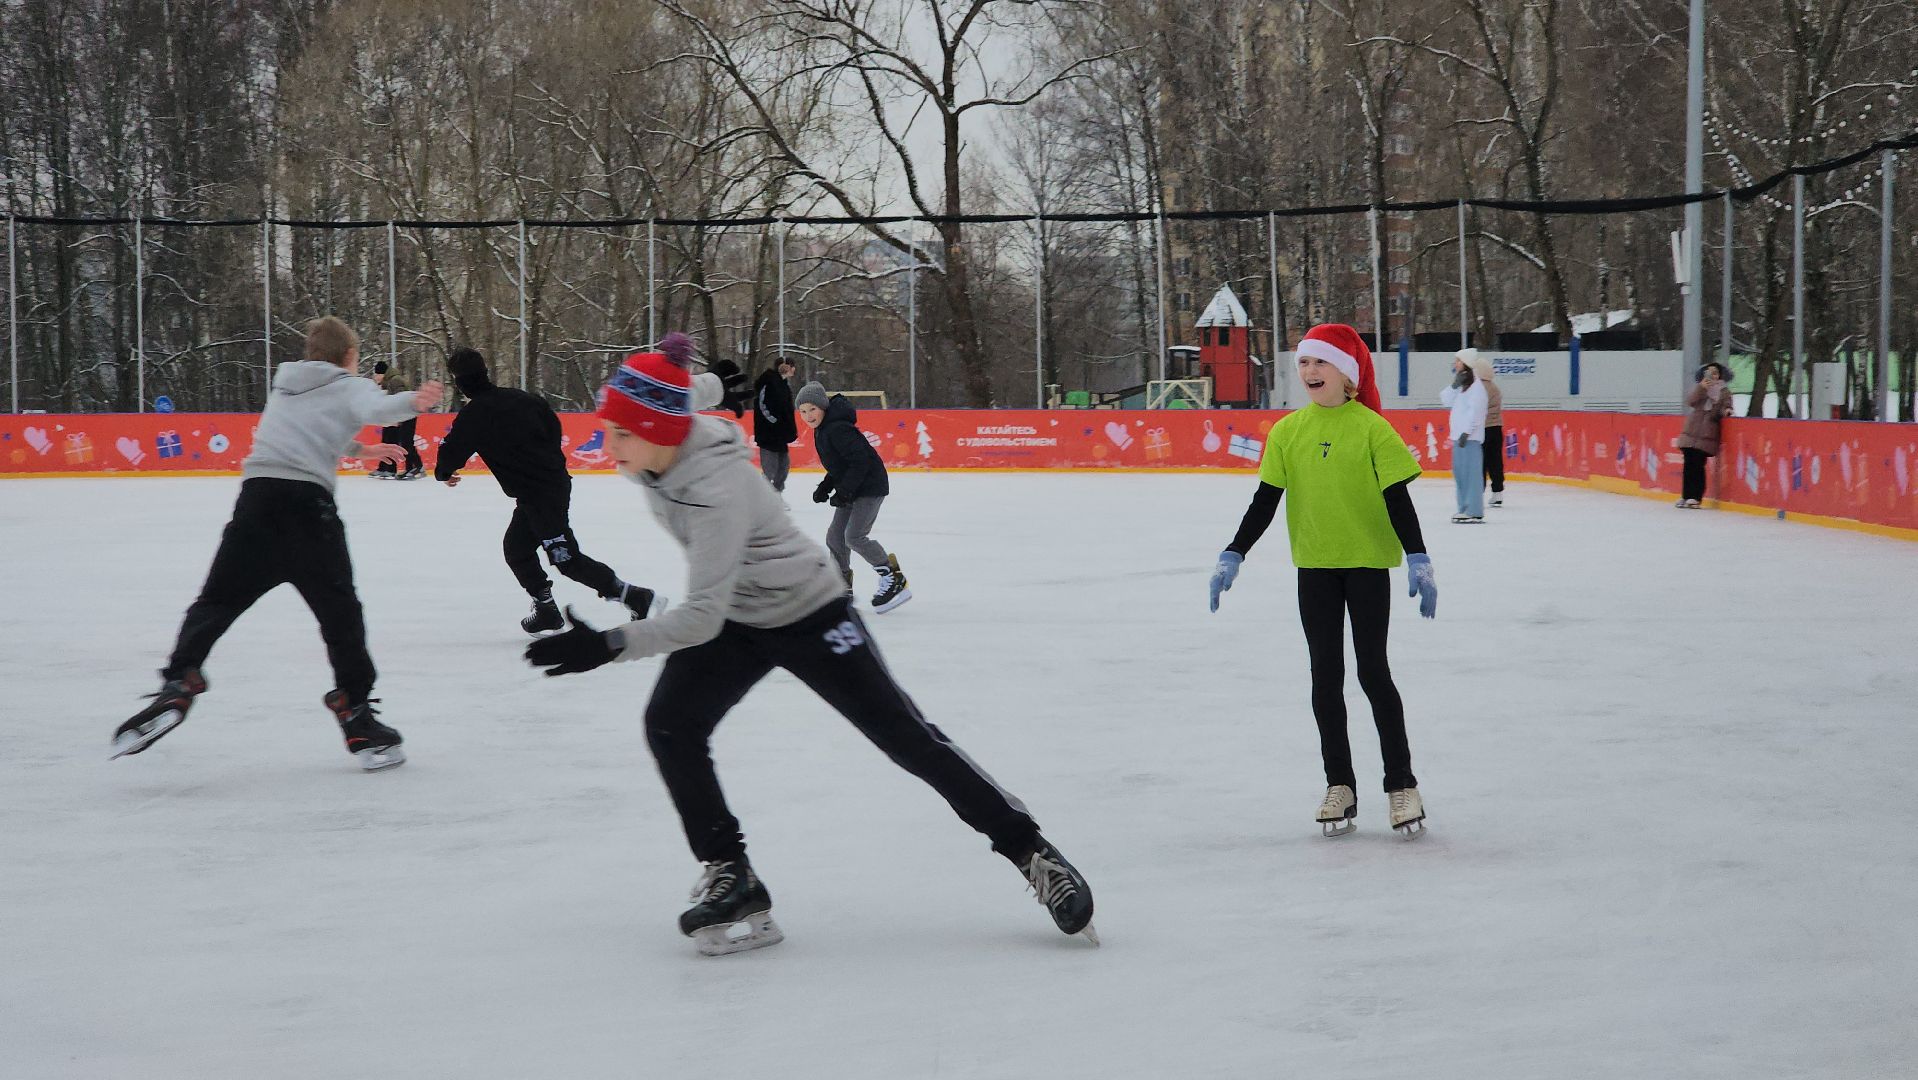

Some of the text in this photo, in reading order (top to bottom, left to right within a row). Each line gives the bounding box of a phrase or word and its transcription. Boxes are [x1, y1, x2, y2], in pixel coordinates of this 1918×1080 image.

[976, 425, 1037, 434] КАТАЙТЕСЬ
[956, 438, 965, 446] С
[823, 621, 864, 654] 39
